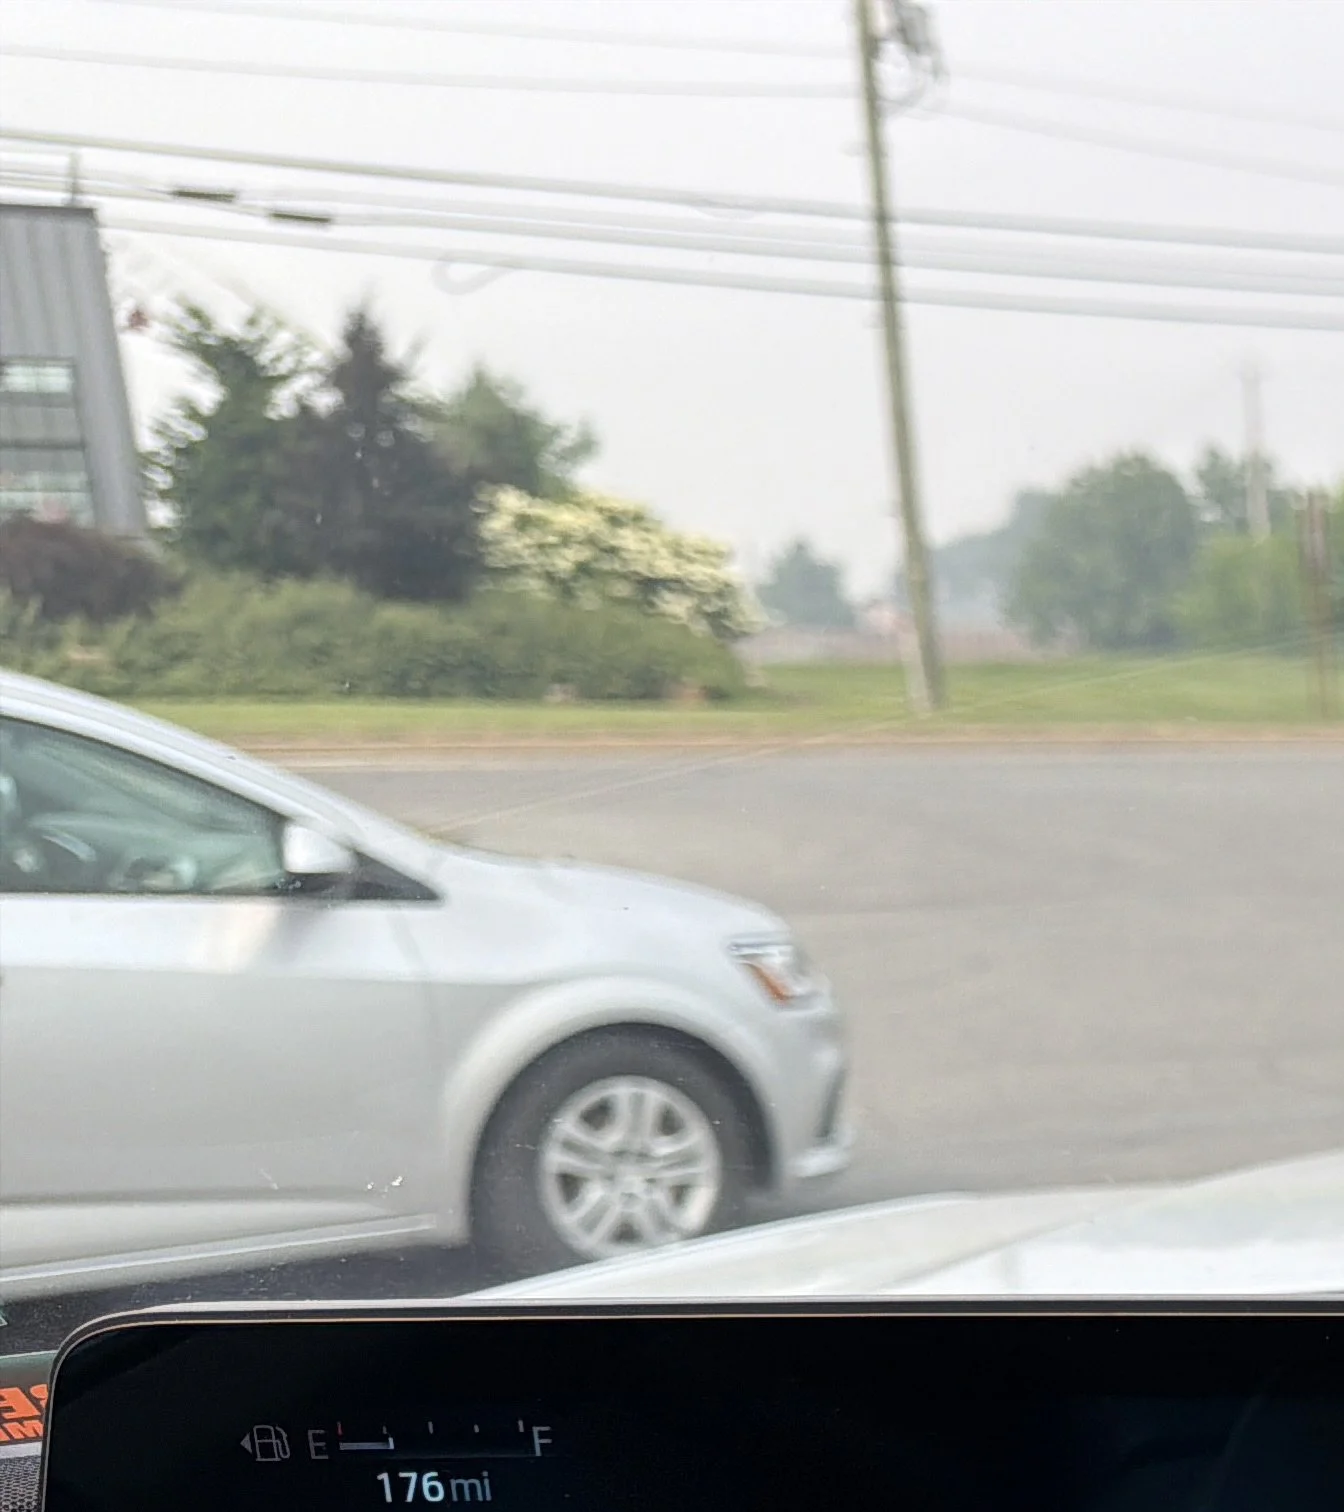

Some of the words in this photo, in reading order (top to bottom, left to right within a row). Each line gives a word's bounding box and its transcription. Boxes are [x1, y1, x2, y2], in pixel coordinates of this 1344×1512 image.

[308, 1430, 329, 1460] E
[532, 1426, 554, 1458] F
[376, 1470, 445, 1503] 176
[450, 1470, 493, 1502] mi
